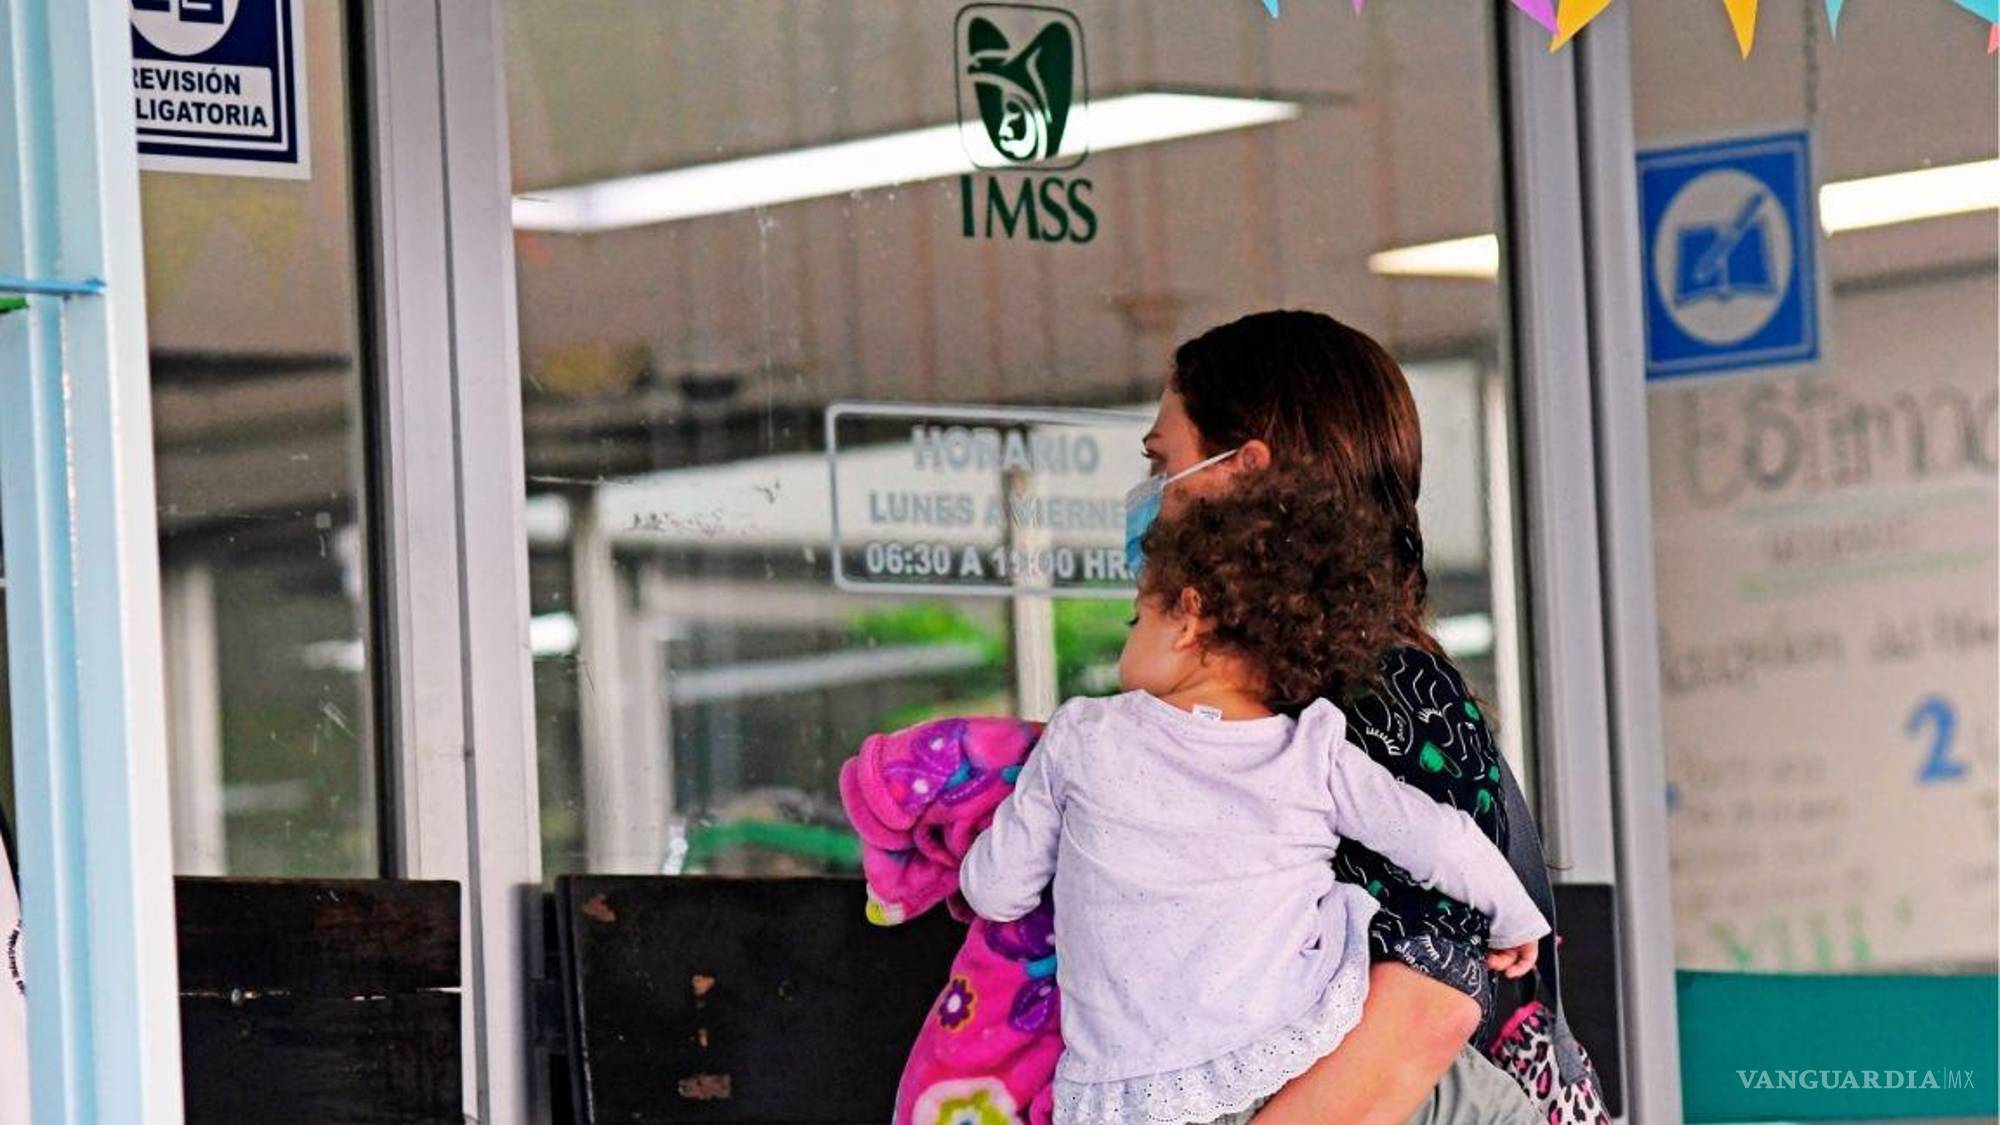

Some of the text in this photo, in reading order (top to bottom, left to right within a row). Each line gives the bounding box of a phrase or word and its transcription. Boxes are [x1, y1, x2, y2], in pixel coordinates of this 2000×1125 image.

[135, 98, 268, 128] LIGATORIA
[960, 174, 1098, 244] IMSS
[912, 424, 1101, 475] HORARIO
[869, 490, 1127, 530] LUNES A VIERNE
[866, 541, 950, 576] 06:30
[960, 542, 983, 577] A
[1905, 695, 1971, 785] 2
